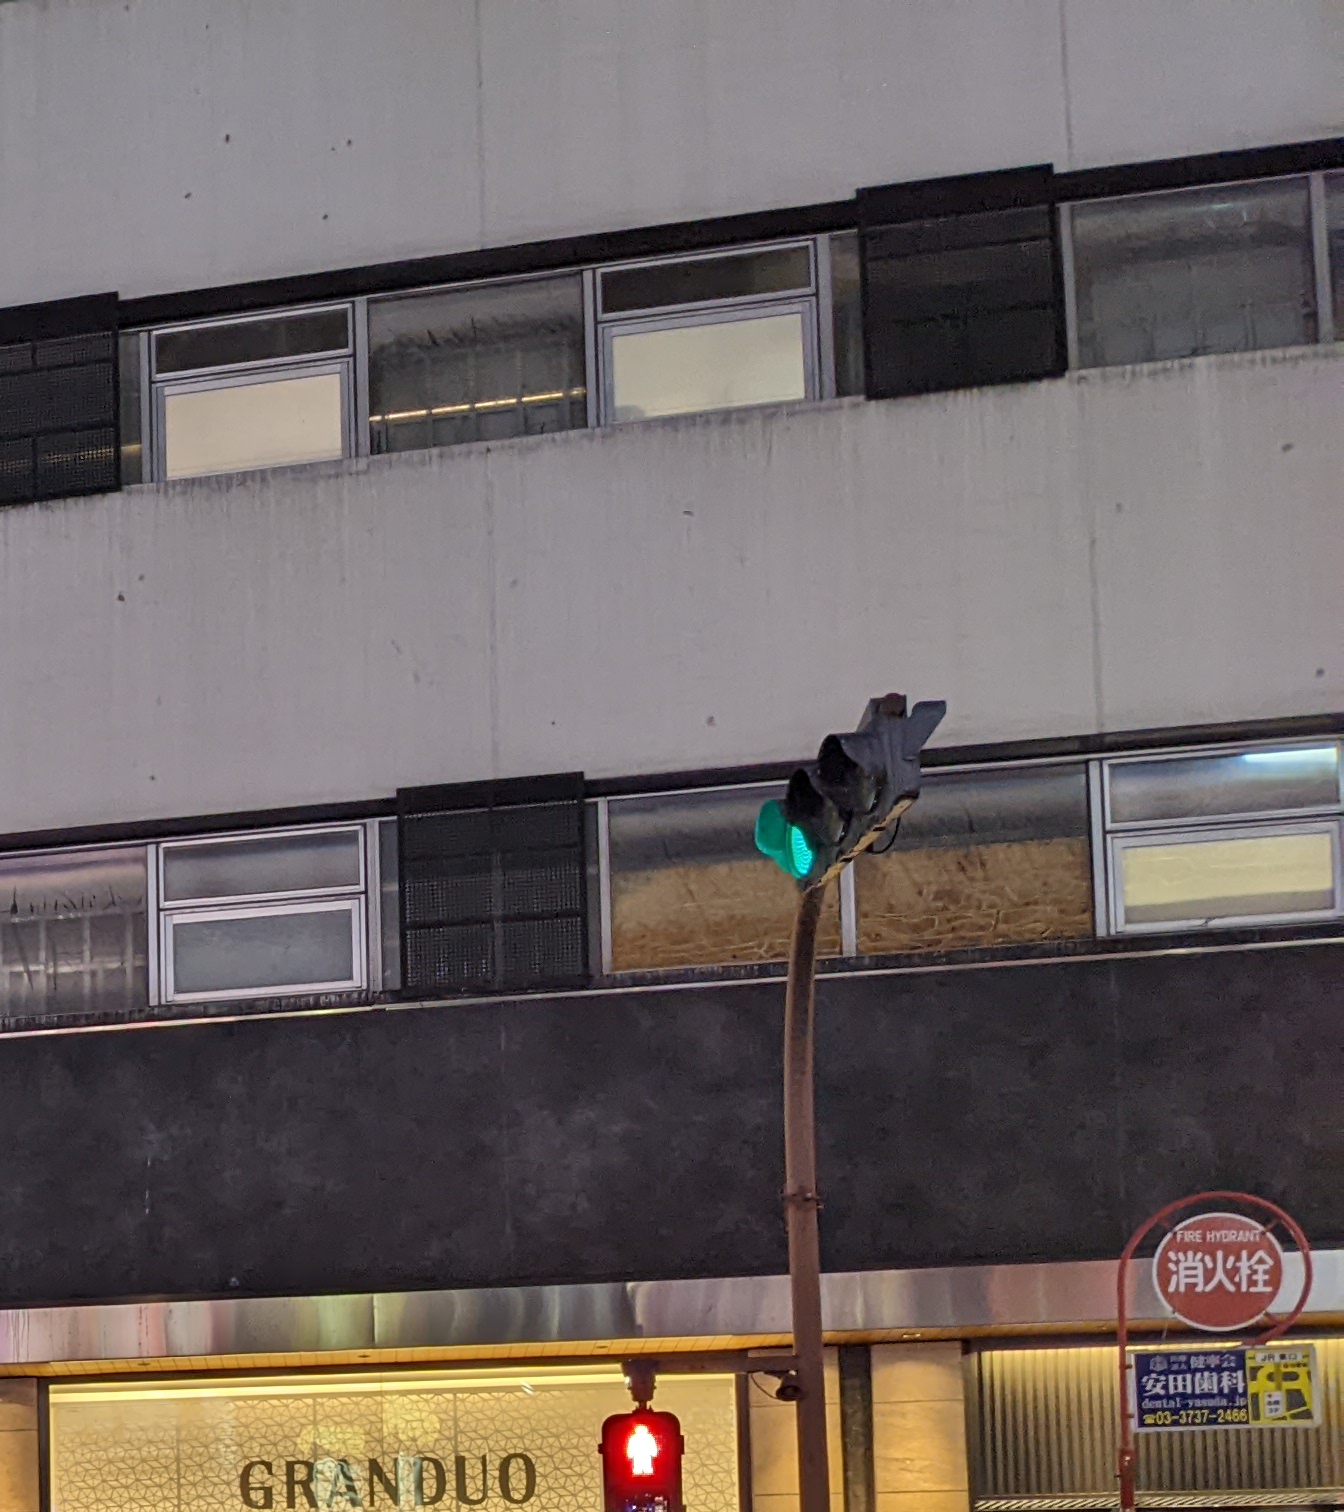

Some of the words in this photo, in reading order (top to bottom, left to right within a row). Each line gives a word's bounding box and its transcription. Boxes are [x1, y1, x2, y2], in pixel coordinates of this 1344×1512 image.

[1176, 1230, 1202, 1243] FIRE
[1206, 1229, 1260, 1242] HYDRANT
[1167, 1249, 1274, 1293] 消火栓
[1142, 1370, 1245, 1395] 安田歯科
[239, 1452, 536, 1510] GRANDUO
